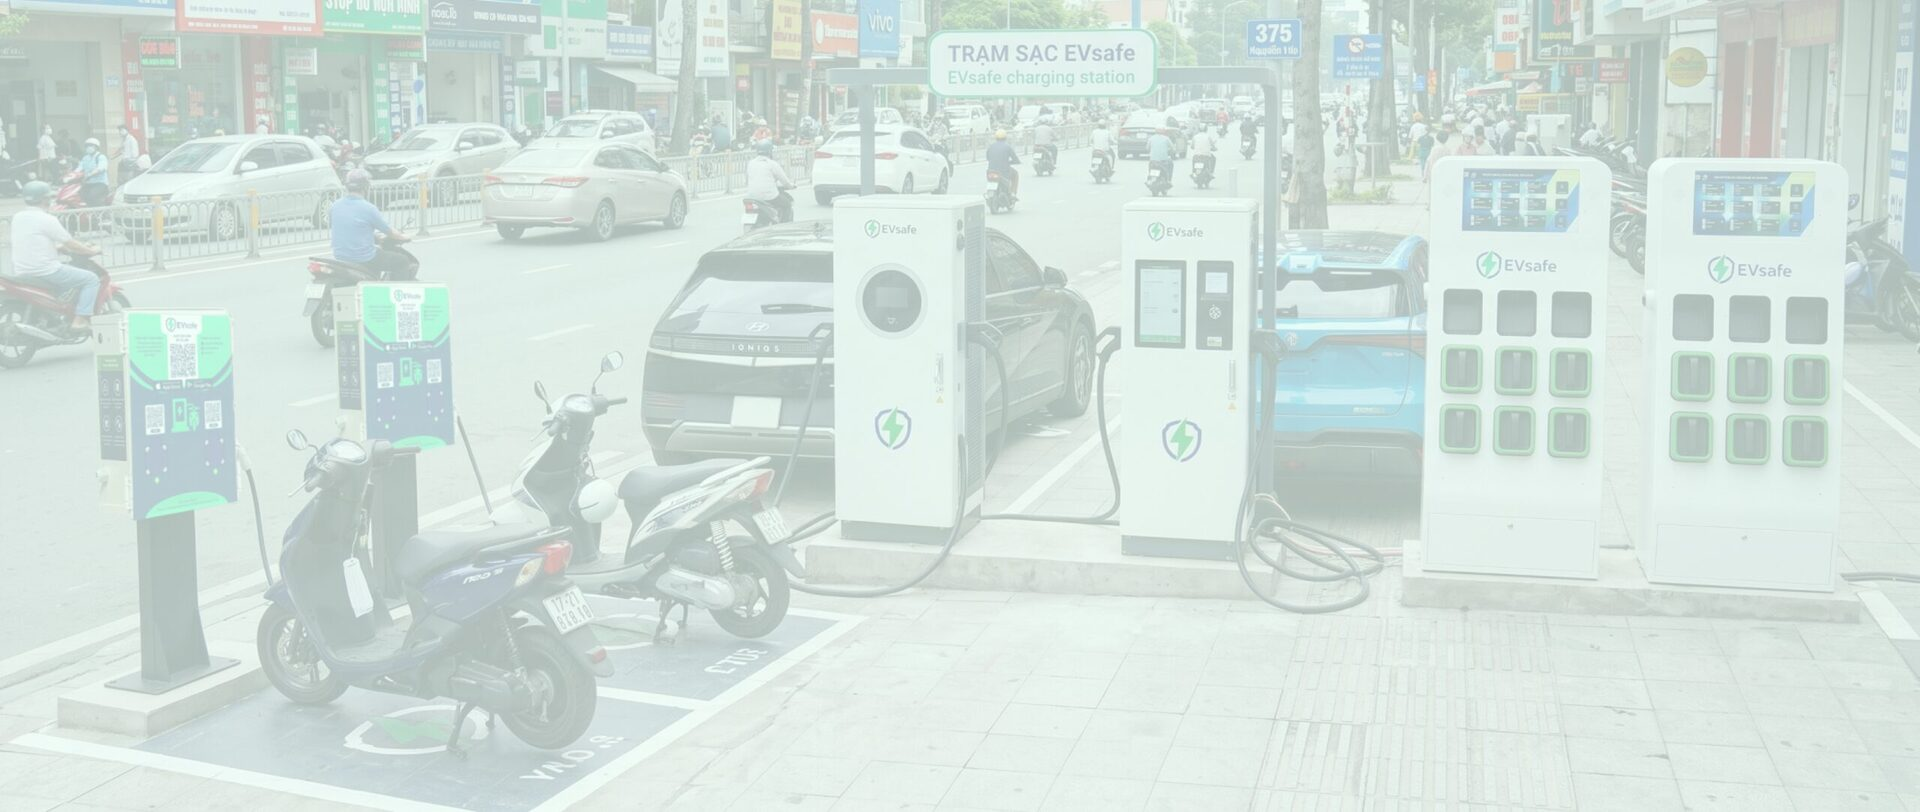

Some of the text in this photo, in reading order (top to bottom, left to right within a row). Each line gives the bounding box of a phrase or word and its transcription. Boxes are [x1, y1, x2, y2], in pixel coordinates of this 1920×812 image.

[868, 9, 894, 33] vivo
[1255, 24, 1292, 43] 375
[948, 42, 1136, 66] TRẠM SẠC EVsafe
[948, 70, 1136, 87] EVsafe charging station
[881, 224, 918, 235] EVsafe
[1166, 226, 1204, 238] EVsafe
[1504, 259, 1557, 273] EVsafe
[1737, 264, 1793, 278] EVsafe
[731, 343, 770, 353] IONIQ
